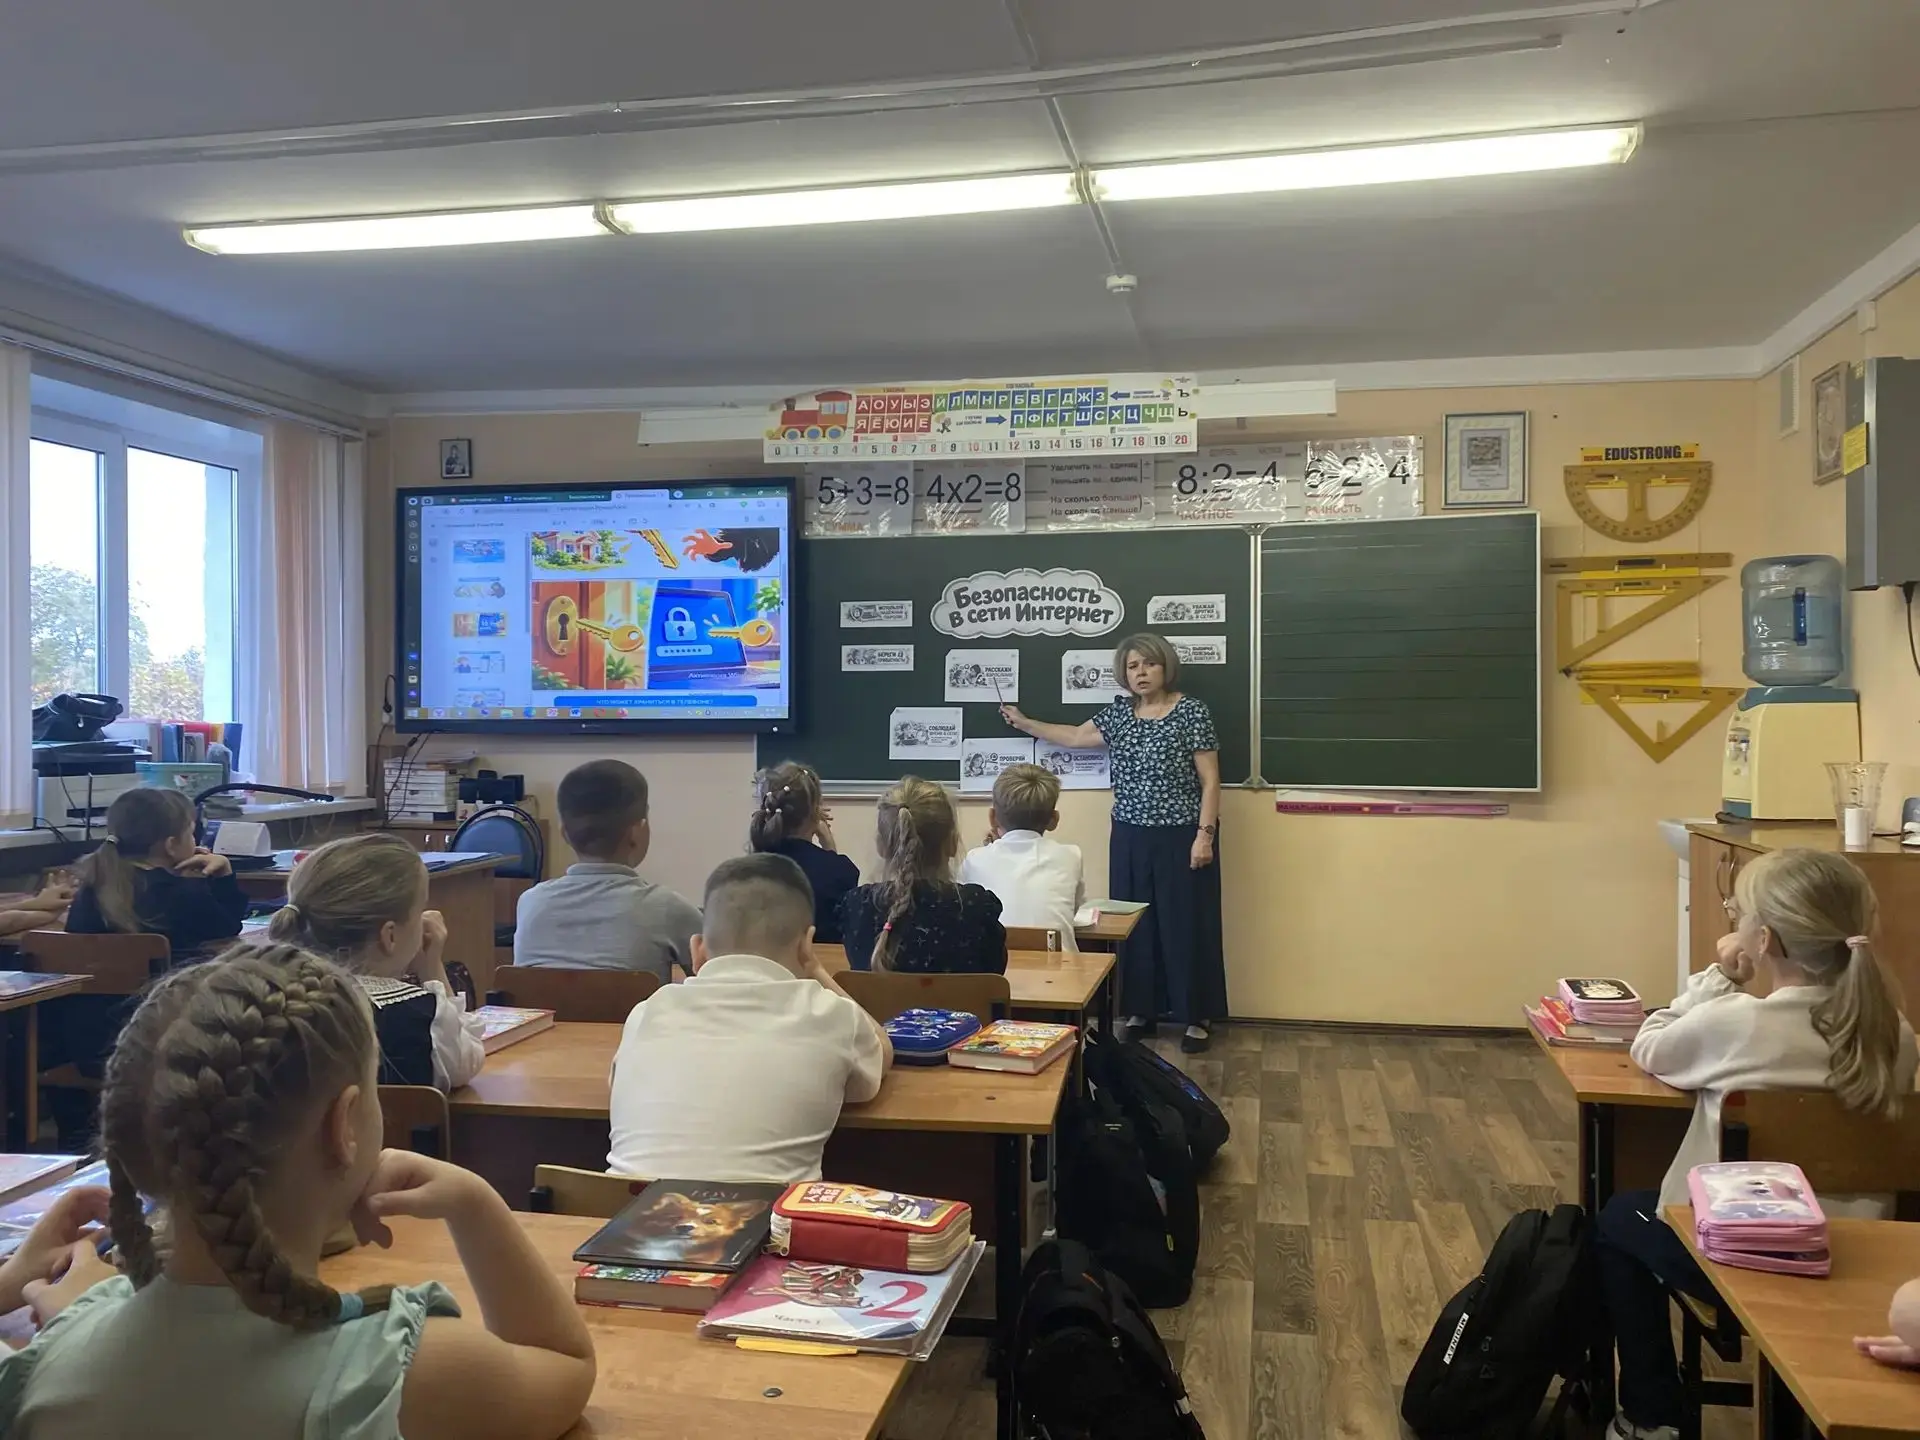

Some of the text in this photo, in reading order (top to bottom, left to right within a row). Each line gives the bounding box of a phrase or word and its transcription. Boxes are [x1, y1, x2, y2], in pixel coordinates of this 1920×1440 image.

[968, 440, 979, 452] 10
[988, 440, 999, 451] 11
[1008, 440, 1020, 451] 12
[1028, 439, 1041, 450] 13
[1048, 438, 1061, 449] 14
[1069, 438, 1083, 449] 15
[1090, 437, 1103, 448] 16
[1111, 437, 1124, 447] 17
[1132, 436, 1145, 446] 18
[1153, 435, 1166, 446] 19
[1174, 434, 1188, 445] 20
[1604, 446, 1682, 461] EDUSTRONG
[817, 476, 910, 505] 5+3=8
[926, 472, 1021, 504] 4x2=8
[1064, 495, 1100, 504] сколько
[953, 585, 1102, 609] Безопасность
[967, 606, 1011, 624] сети
[1015, 602, 1114, 625] Интернет
[860, 1280, 929, 1320] 2
